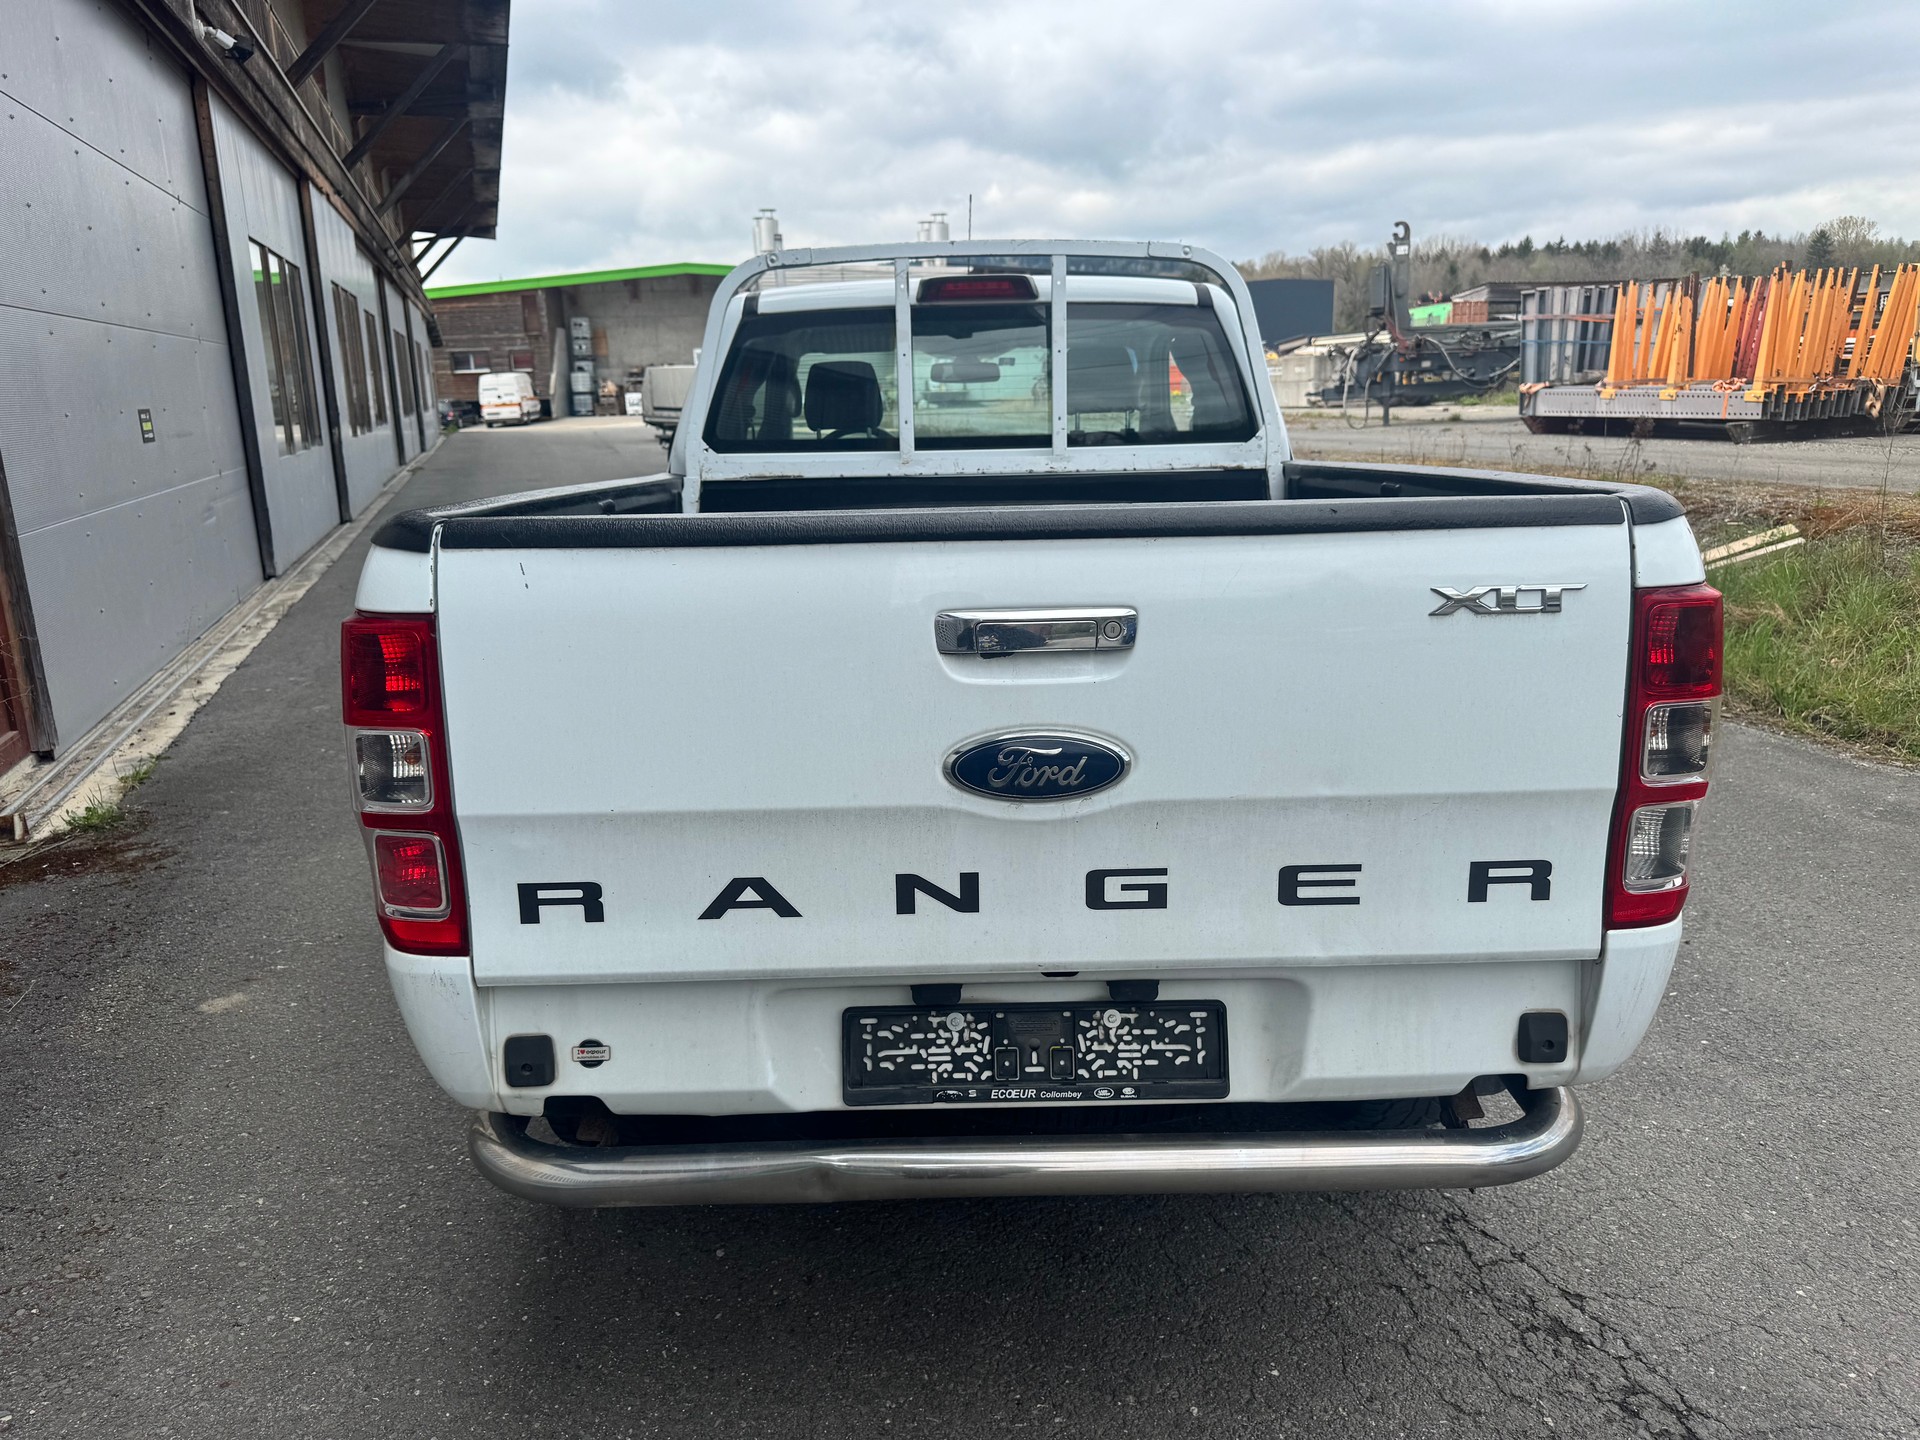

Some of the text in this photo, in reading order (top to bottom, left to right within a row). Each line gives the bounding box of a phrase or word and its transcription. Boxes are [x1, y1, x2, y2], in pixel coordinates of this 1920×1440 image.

[1428, 583, 1589, 616] XLT
[987, 746, 1087, 788] Ford
[517, 859, 1553, 924] RANGER
[1040, 1091, 1083, 1099] Collombey
